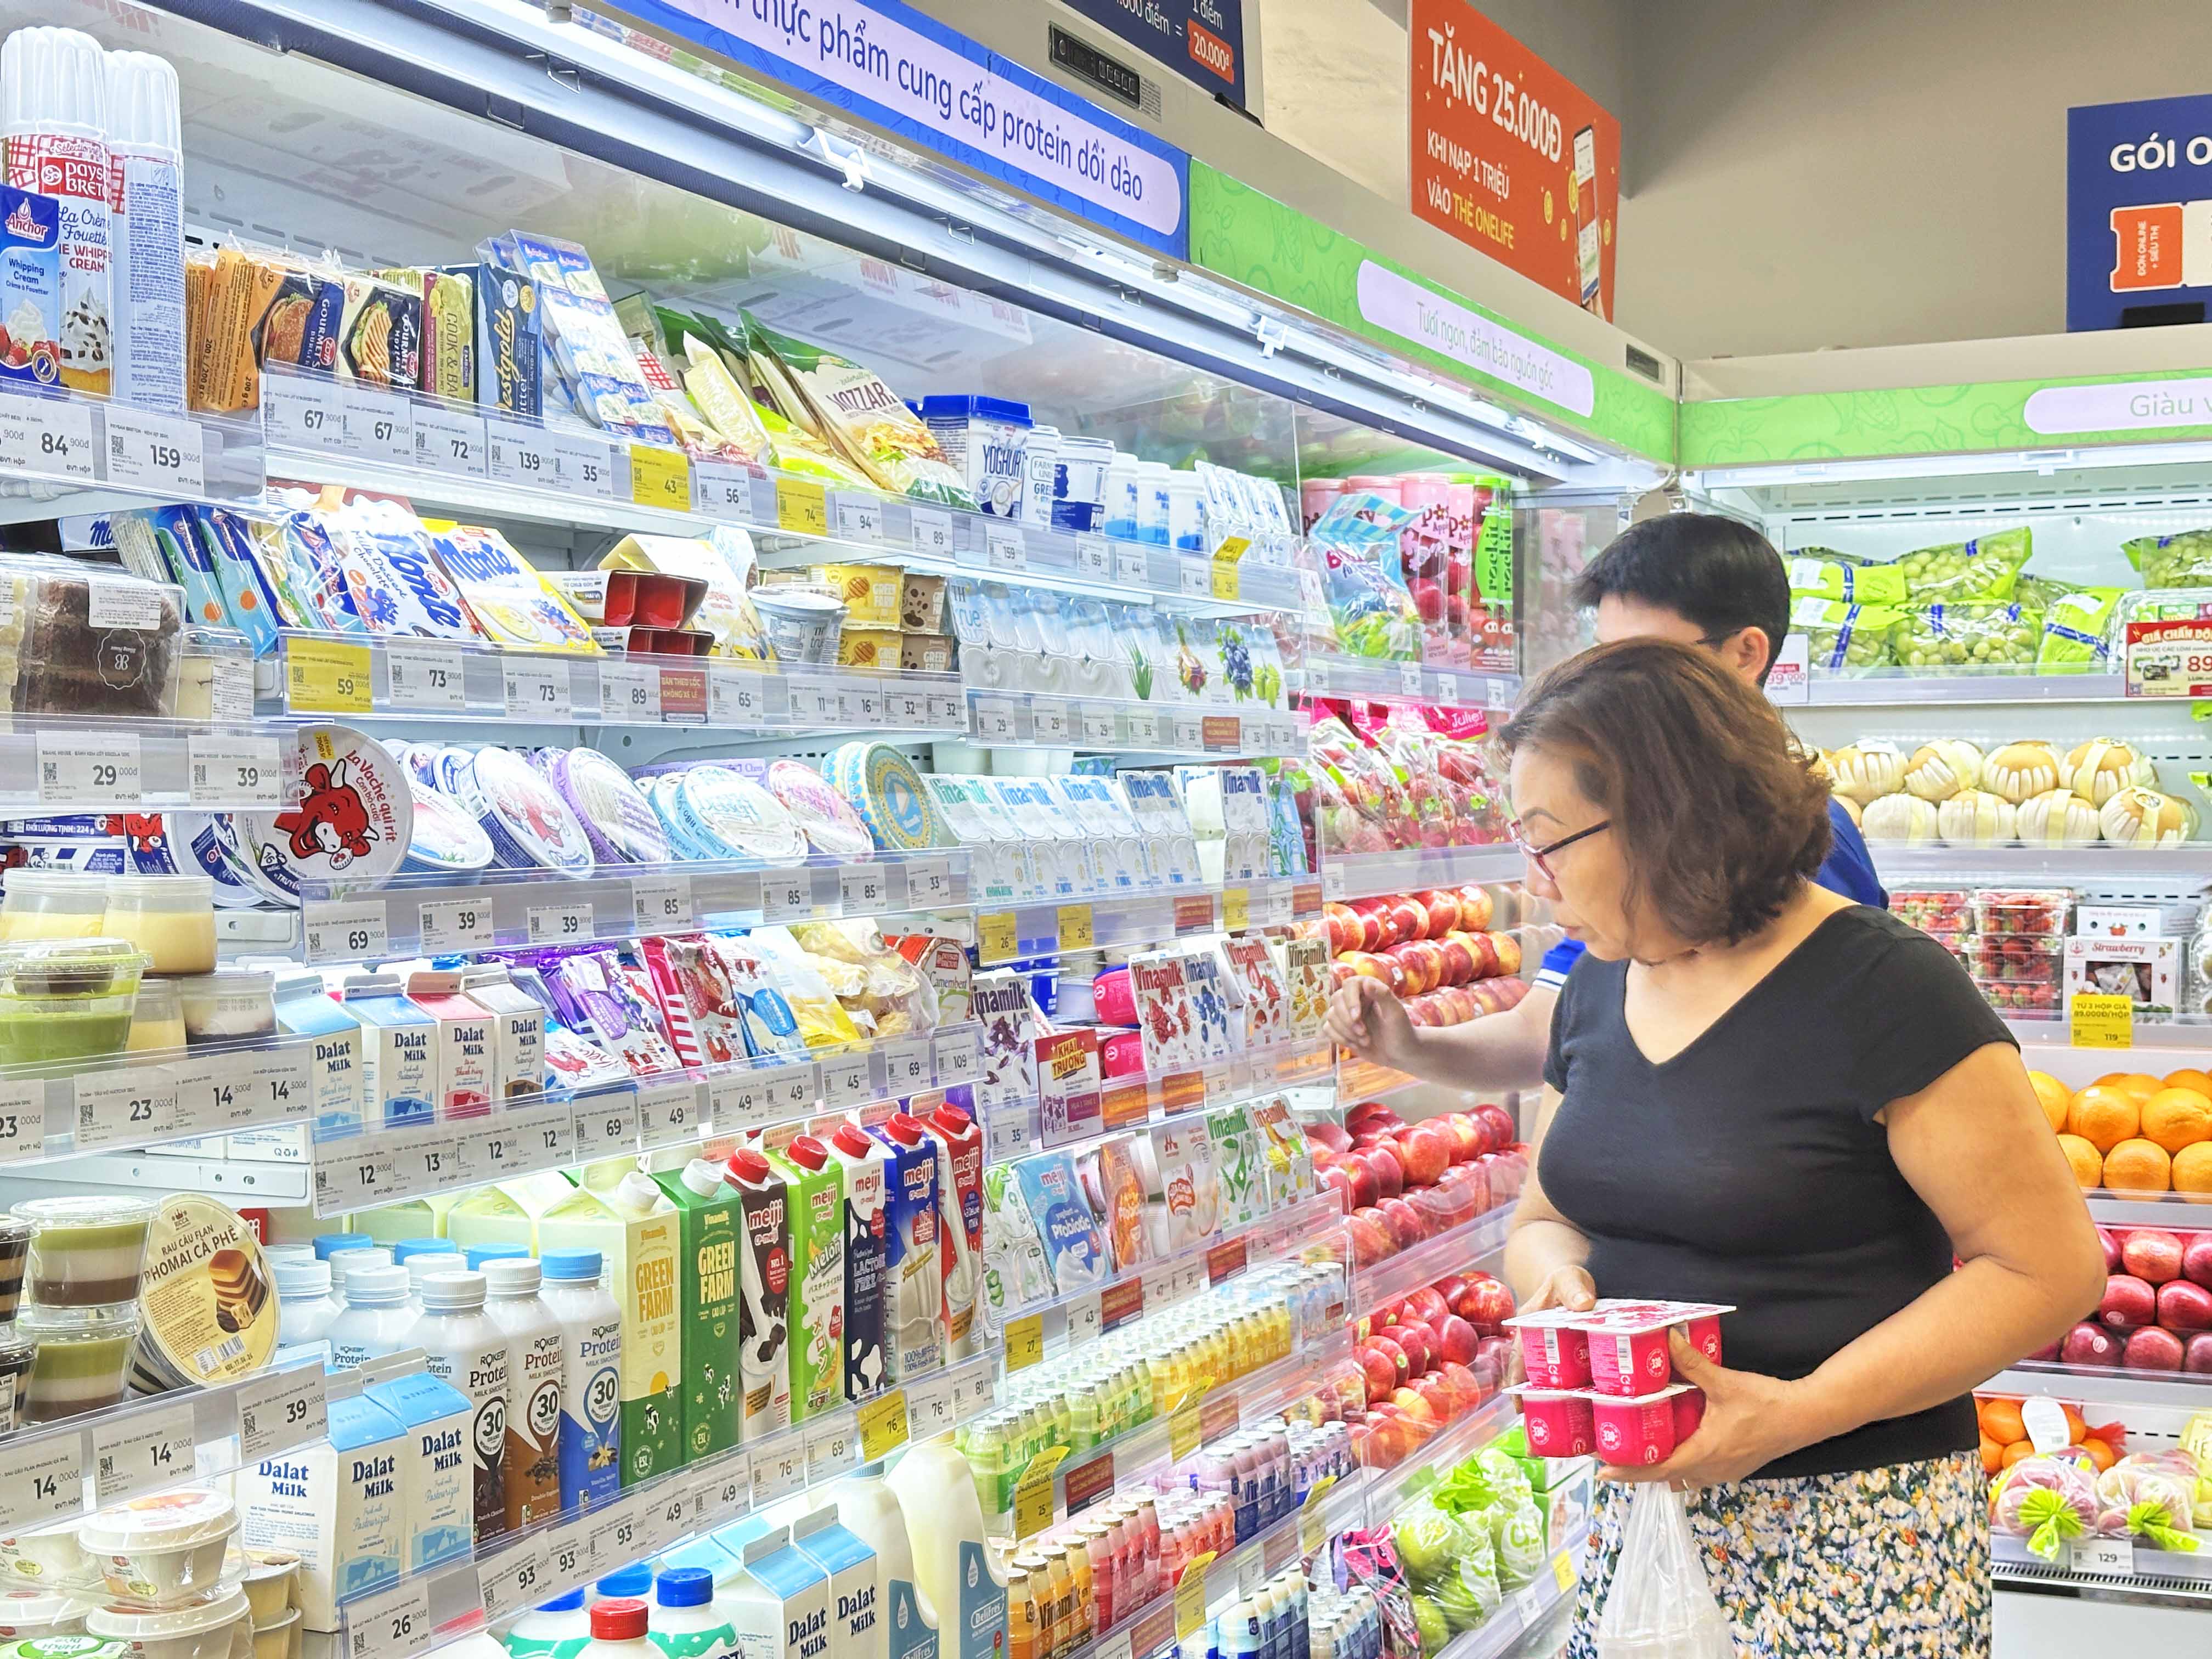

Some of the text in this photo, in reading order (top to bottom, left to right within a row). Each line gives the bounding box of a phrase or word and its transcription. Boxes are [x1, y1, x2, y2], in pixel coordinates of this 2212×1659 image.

[1144, 1, 1170, 35] điểm
[1427, 22, 1561, 163] TẶNG 25.000Đ
[820, 20, 1142, 201] phẩm cung cấp protein dồi dào
[2110, 132, 2175, 172] GÓI
[65, 163, 104, 180] pays
[1427, 129, 1509, 202] KHI NẠP 1 TRIỆU
[59, 206, 78, 223] La
[1427, 175, 1514, 250] VÀO THẺ ONELIFE
[7, 217, 48, 237] Anchor
[2137, 220, 2147, 253] ONLINE
[8, 258, 45, 276] Whipping
[14, 270, 39, 285] Cream
[69, 258, 105, 273] CREAM
[447, 313, 459, 357] COOK
[1416, 302, 1554, 391] Tươi ngon, đảm bảo nguồn gốc
[2130, 392, 2192, 417] Giàu
[41, 433, 68, 456] 84
[150, 445, 180, 469] 159
[983, 444, 1027, 478] YOGHURT
[352, 529, 408, 600] Milk Dessert
[353, 546, 390, 590] Chocolate
[432, 537, 521, 583] Monte
[1487, 524, 1498, 592] rockit
[1502, 523, 1513, 593] rockit
[953, 585, 966, 602] TH
[1452, 711, 1481, 726] Juliet
[92, 765, 117, 786] 29
[238, 768, 259, 787] 39
[356, 777, 370, 792] con
[1223, 769, 1262, 794] Vinamilk
[345, 749, 396, 842] La Vache qui rit
[76, 825, 89, 833] 224
[1226, 939, 1269, 964] Vinamilk
[1287, 943, 1328, 968] Vinamilk
[2091, 943, 2146, 956] Strawberry
[929, 971, 967, 990] Camembert
[1132, 961, 1185, 989] Vinamilk
[454, 1027, 485, 1043] Dalat
[511, 1019, 538, 1035] Dalat
[315, 1040, 351, 1062] Dalat
[394, 1032, 427, 1049] Dalat
[462, 1043, 484, 1057] Milk
[519, 1034, 537, 1047] Milk
[1057, 1040, 1077, 1058] KHAI
[327, 1057, 352, 1074] Milk
[404, 1048, 427, 1062] Milk
[214, 1085, 233, 1106] 14
[271, 1080, 289, 1101] 14
[129, 1100, 153, 1121] 23
[1207, 1111, 1251, 1141] Vinamilk
[904, 1158, 934, 1187] meiji
[954, 1146, 980, 1175] meiji
[855, 1167, 881, 1194] meiji
[1041, 1166, 1067, 1185] meiji
[811, 1183, 837, 1209] meiji
[174, 1217, 190, 1228] RICCA
[749, 1199, 784, 1231] meiji
[640, 1225, 667, 1243] Vinamilk
[1052, 1215, 1092, 1240] Probiotic
[161, 1224, 215, 1256] RAU CÂU FLAN
[143, 1226, 240, 1285] PHOMAI CÀ PHÊ
[698, 1240, 735, 1277] GREEN
[636, 1256, 674, 1292] GREEN
[700, 1271, 734, 1305] FARM
[637, 1285, 674, 1323] FARM
[592, 1321, 620, 1340] ROKEBY
[534, 1334, 561, 1352] ROKEBY
[474, 1386, 489, 1398] MILK
[594, 1378, 615, 1405] 30
[286, 1400, 307, 1424] 39
[537, 1391, 558, 1418] 30
[482, 1408, 503, 1437] 30
[421, 1427, 462, 1458] Dalat
[697, 1434, 708, 1445] ESL
[150, 1442, 172, 1466] 14
[433, 1452, 462, 1474] Milk
[638, 1455, 648, 1466] ESL
[259, 1460, 309, 1481] Dalat
[352, 1454, 396, 1483] Dalat
[33, 1475, 57, 1500] 14
[271, 1481, 307, 1498] Milk
[364, 1478, 394, 1500] Milk
[2098, 1553, 2118, 1563] 129
[838, 1583, 876, 1620] Dalat
[392, 1615, 411, 1639] 26
[788, 1606, 827, 1645] Dalat
[849, 1609, 876, 1637] Milk
[799, 1634, 827, 1659] Milk
